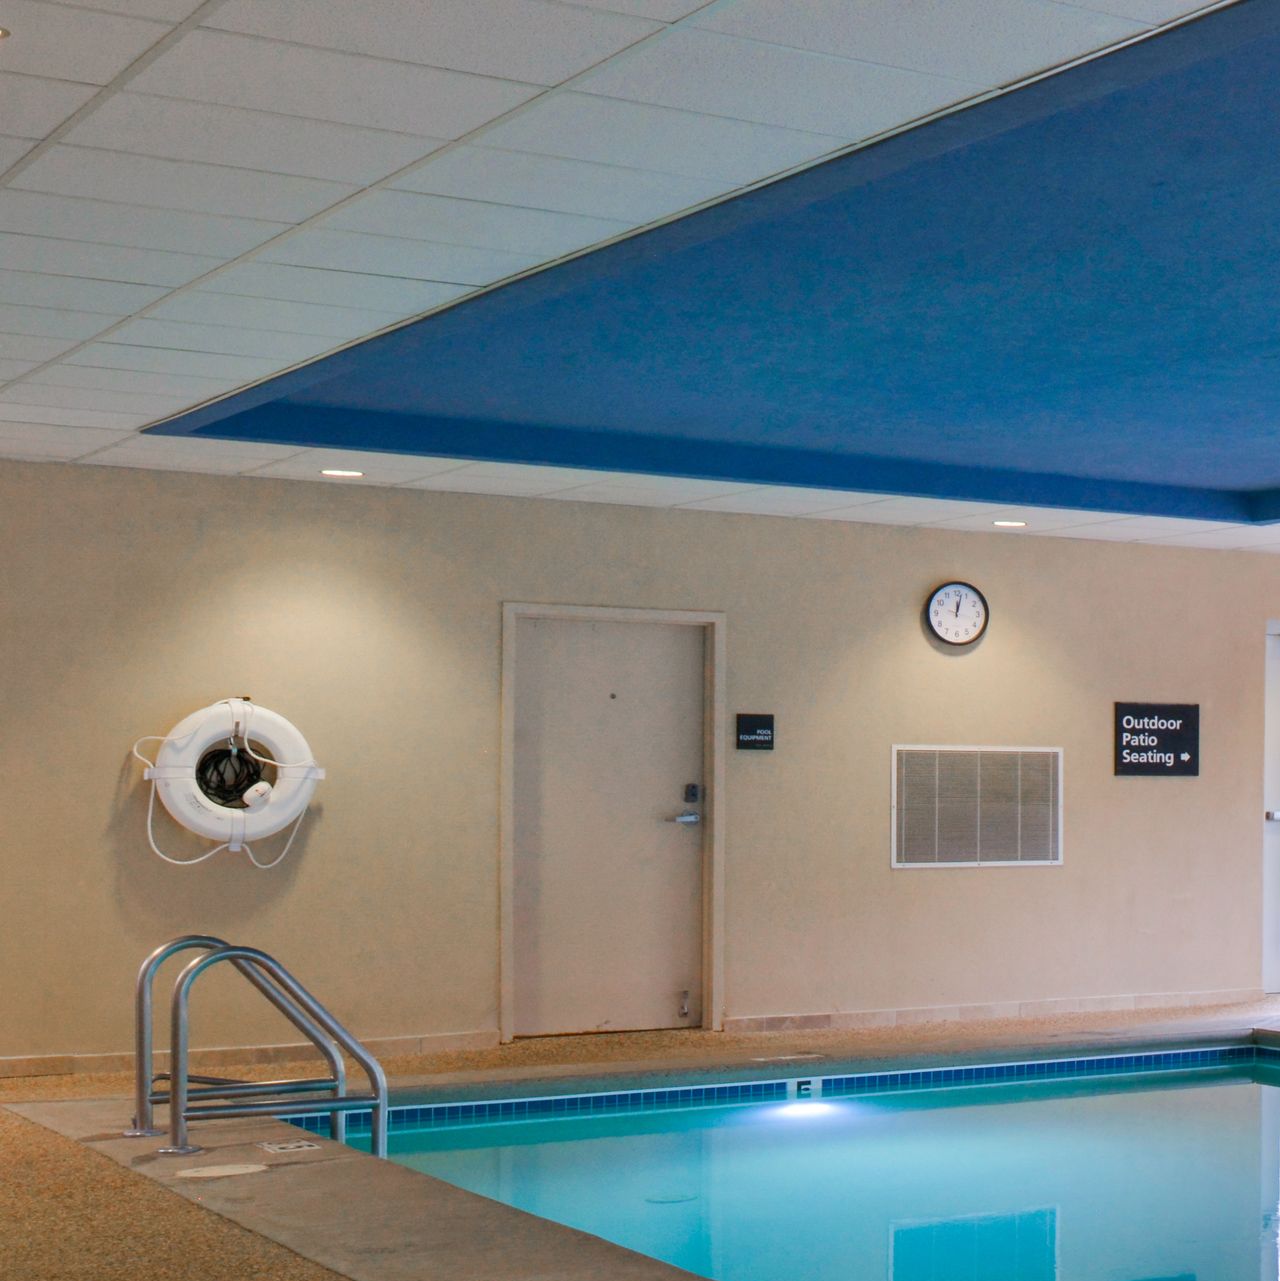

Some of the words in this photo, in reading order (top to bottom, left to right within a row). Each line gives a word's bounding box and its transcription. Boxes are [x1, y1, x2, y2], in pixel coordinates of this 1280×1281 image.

[1122, 716, 1182, 730] Outdoor
[1122, 733, 1157, 746] Patio
[1122, 750, 1174, 766] Seating
